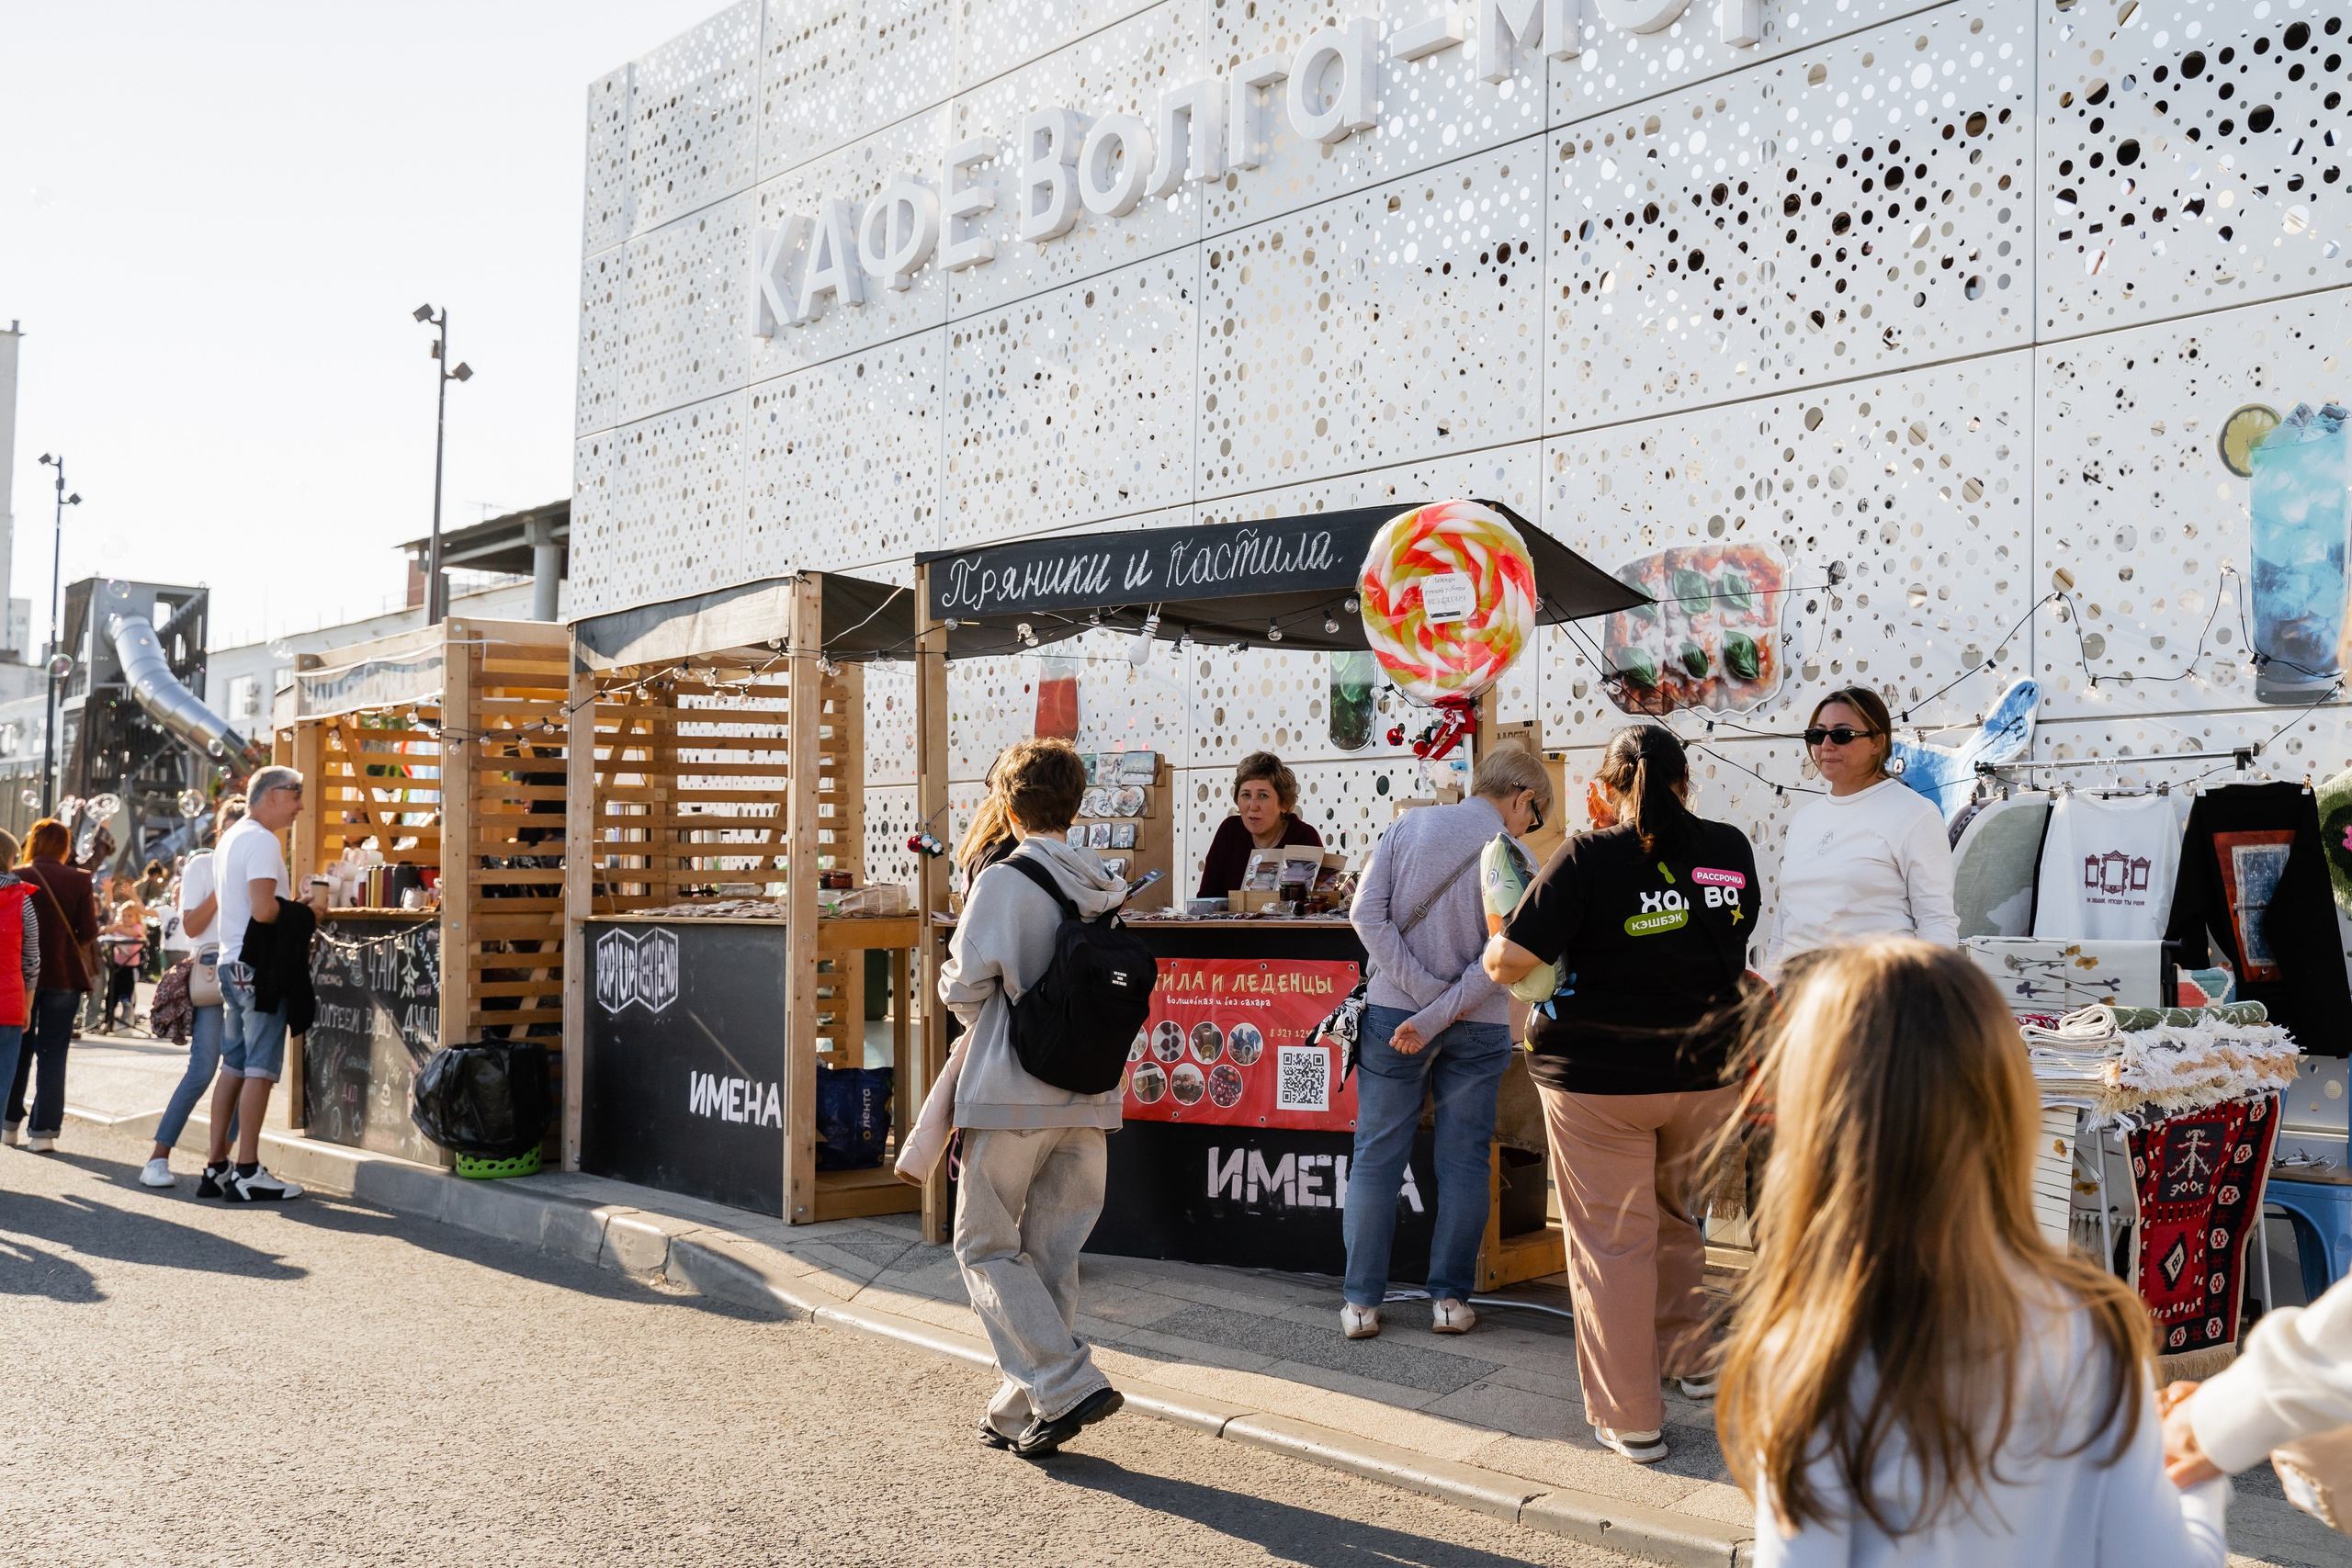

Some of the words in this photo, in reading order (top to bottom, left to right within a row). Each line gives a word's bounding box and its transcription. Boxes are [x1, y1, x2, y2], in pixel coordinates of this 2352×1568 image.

[752, 135, 998, 338] КАФЕ
[942, 551, 1111, 611] Пряники
[1124, 548, 1152, 590] и
[1696, 872, 1743, 885] РАССРОЧКА
[1631, 912, 1683, 931] КЭШБЭК
[599, 942, 616, 998] POP
[618, 942, 635, 1001] UP
[1212, 974, 1225, 992] И
[1231, 973, 1334, 996] ЛЕДЕНЦЫ
[1166, 994, 1214, 1006] волшебная
[1216, 997, 1222, 1006] и
[1224, 996, 1238, 1007] без
[1240, 998, 1272, 1010] сахара
[1269, 1028, 1274, 1038] 8
[1277, 1028, 1292, 1038] 927
[689, 1070, 783, 1129] ИМЕНА
